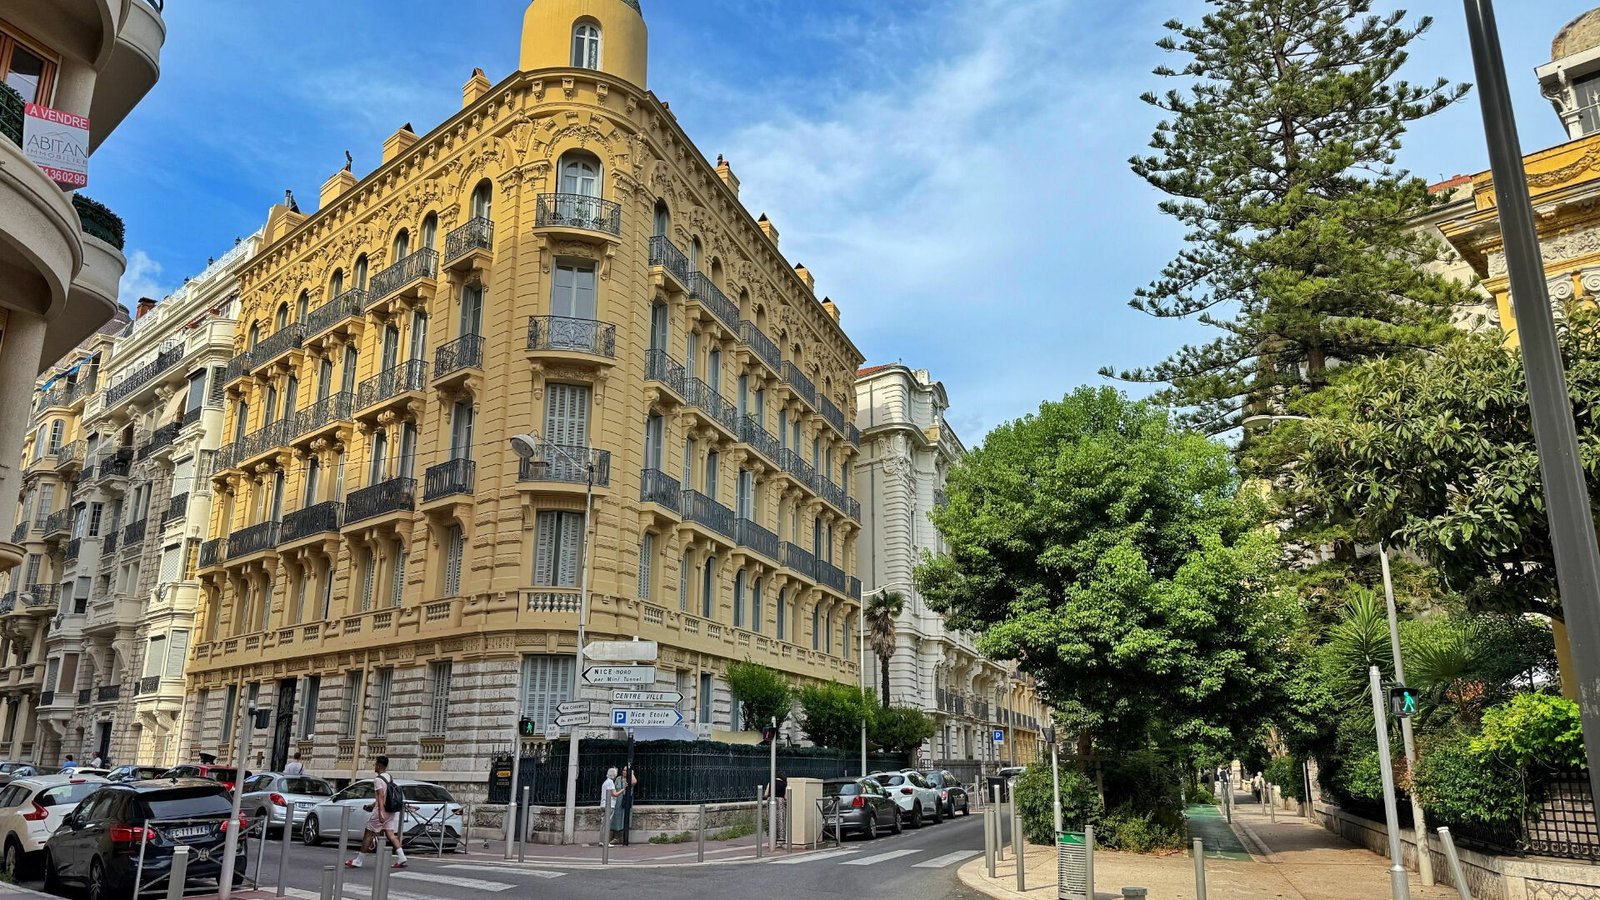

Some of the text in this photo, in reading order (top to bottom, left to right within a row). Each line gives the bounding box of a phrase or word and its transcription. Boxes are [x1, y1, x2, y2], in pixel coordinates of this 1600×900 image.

[30, 106, 87, 129] A VENDRE
[616, 713, 624, 722] P
